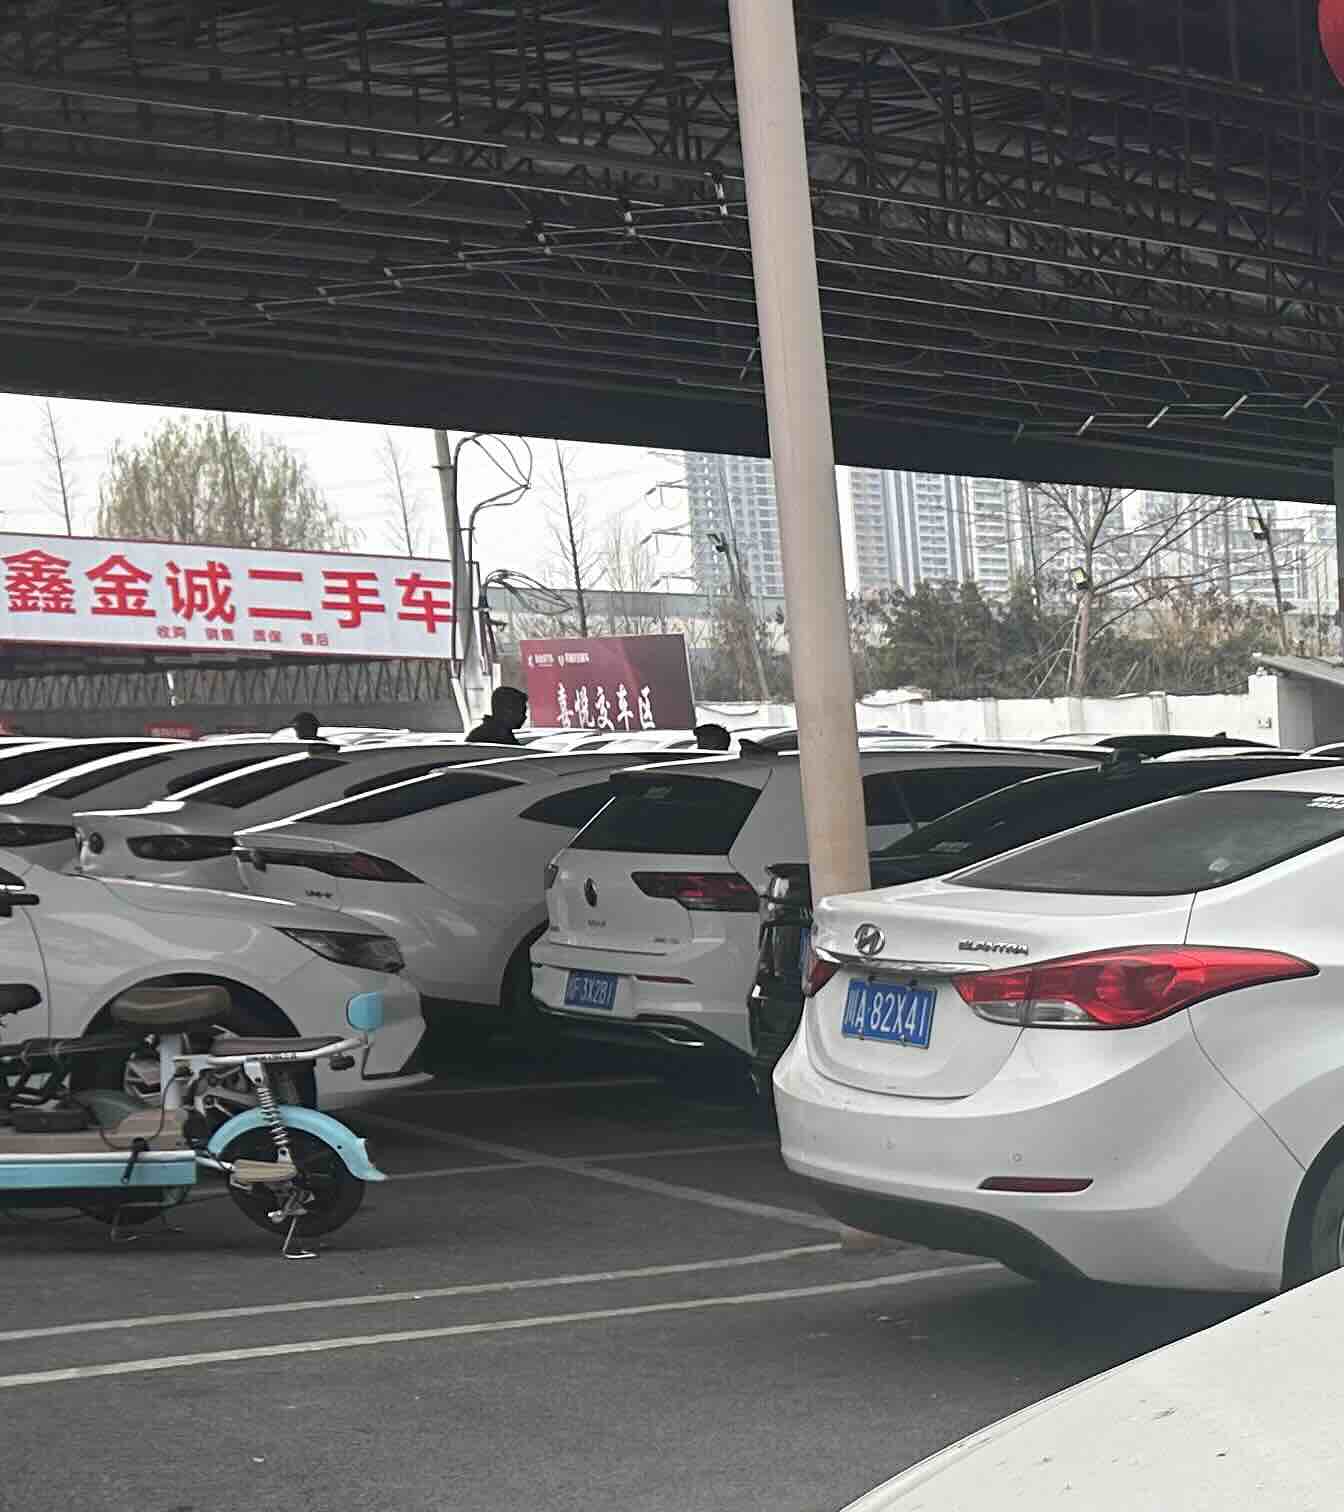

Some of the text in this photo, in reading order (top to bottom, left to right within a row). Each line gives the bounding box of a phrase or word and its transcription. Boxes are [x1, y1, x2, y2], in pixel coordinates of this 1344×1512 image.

[1, 549, 457, 633] 鑫金诚二手车
